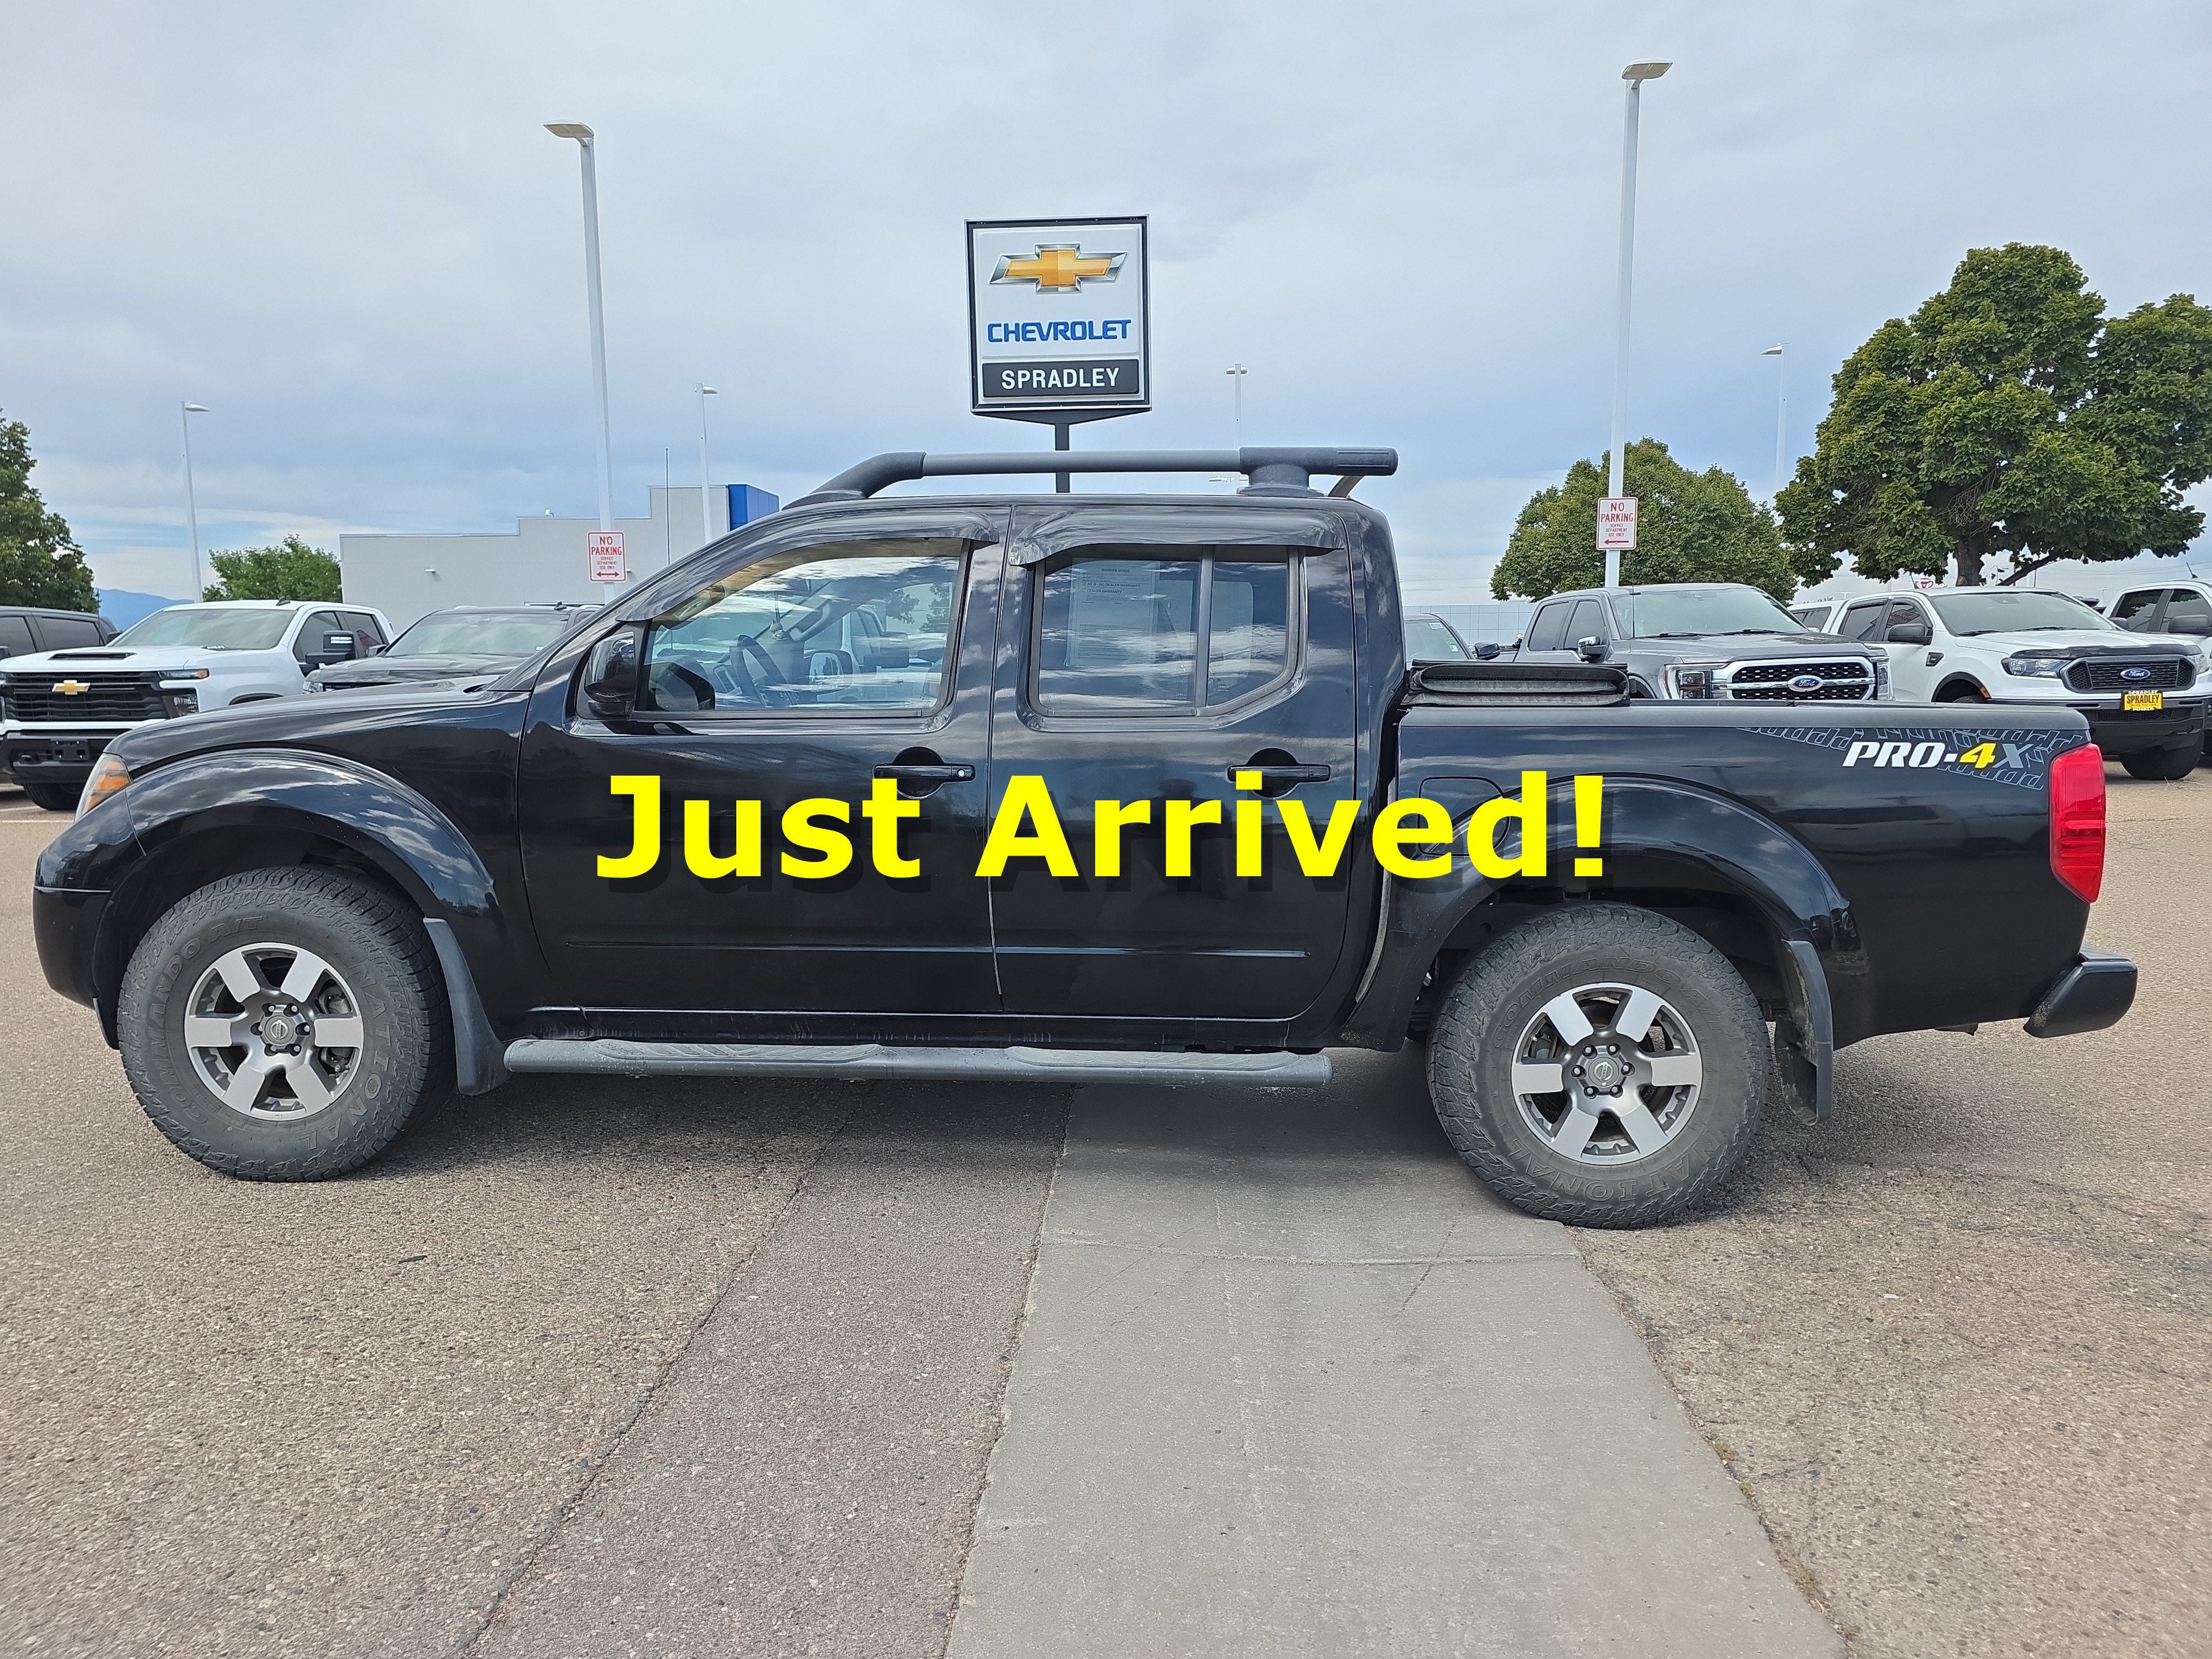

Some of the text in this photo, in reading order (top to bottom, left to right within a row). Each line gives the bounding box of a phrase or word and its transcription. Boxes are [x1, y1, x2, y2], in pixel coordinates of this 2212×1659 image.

[988, 319, 1131, 343] CHEVROLET
[1001, 367, 1120, 389] SPRADLEY
[1600, 513, 1634, 523] PARKING
[1610, 502, 1625, 512] NO
[591, 546, 622, 555] PARKING
[600, 536, 613, 545] NO
[2126, 695, 2160, 704] SPRADLEY
[1841, 741, 2034, 769] PRO-4X
[1492, 956, 1681, 1048] COMMANDO
[148, 938, 208, 1124] COMMANDO
[299, 962, 391, 1150] NATIONAL
[1508, 1129, 1721, 1202] NATIONAL
